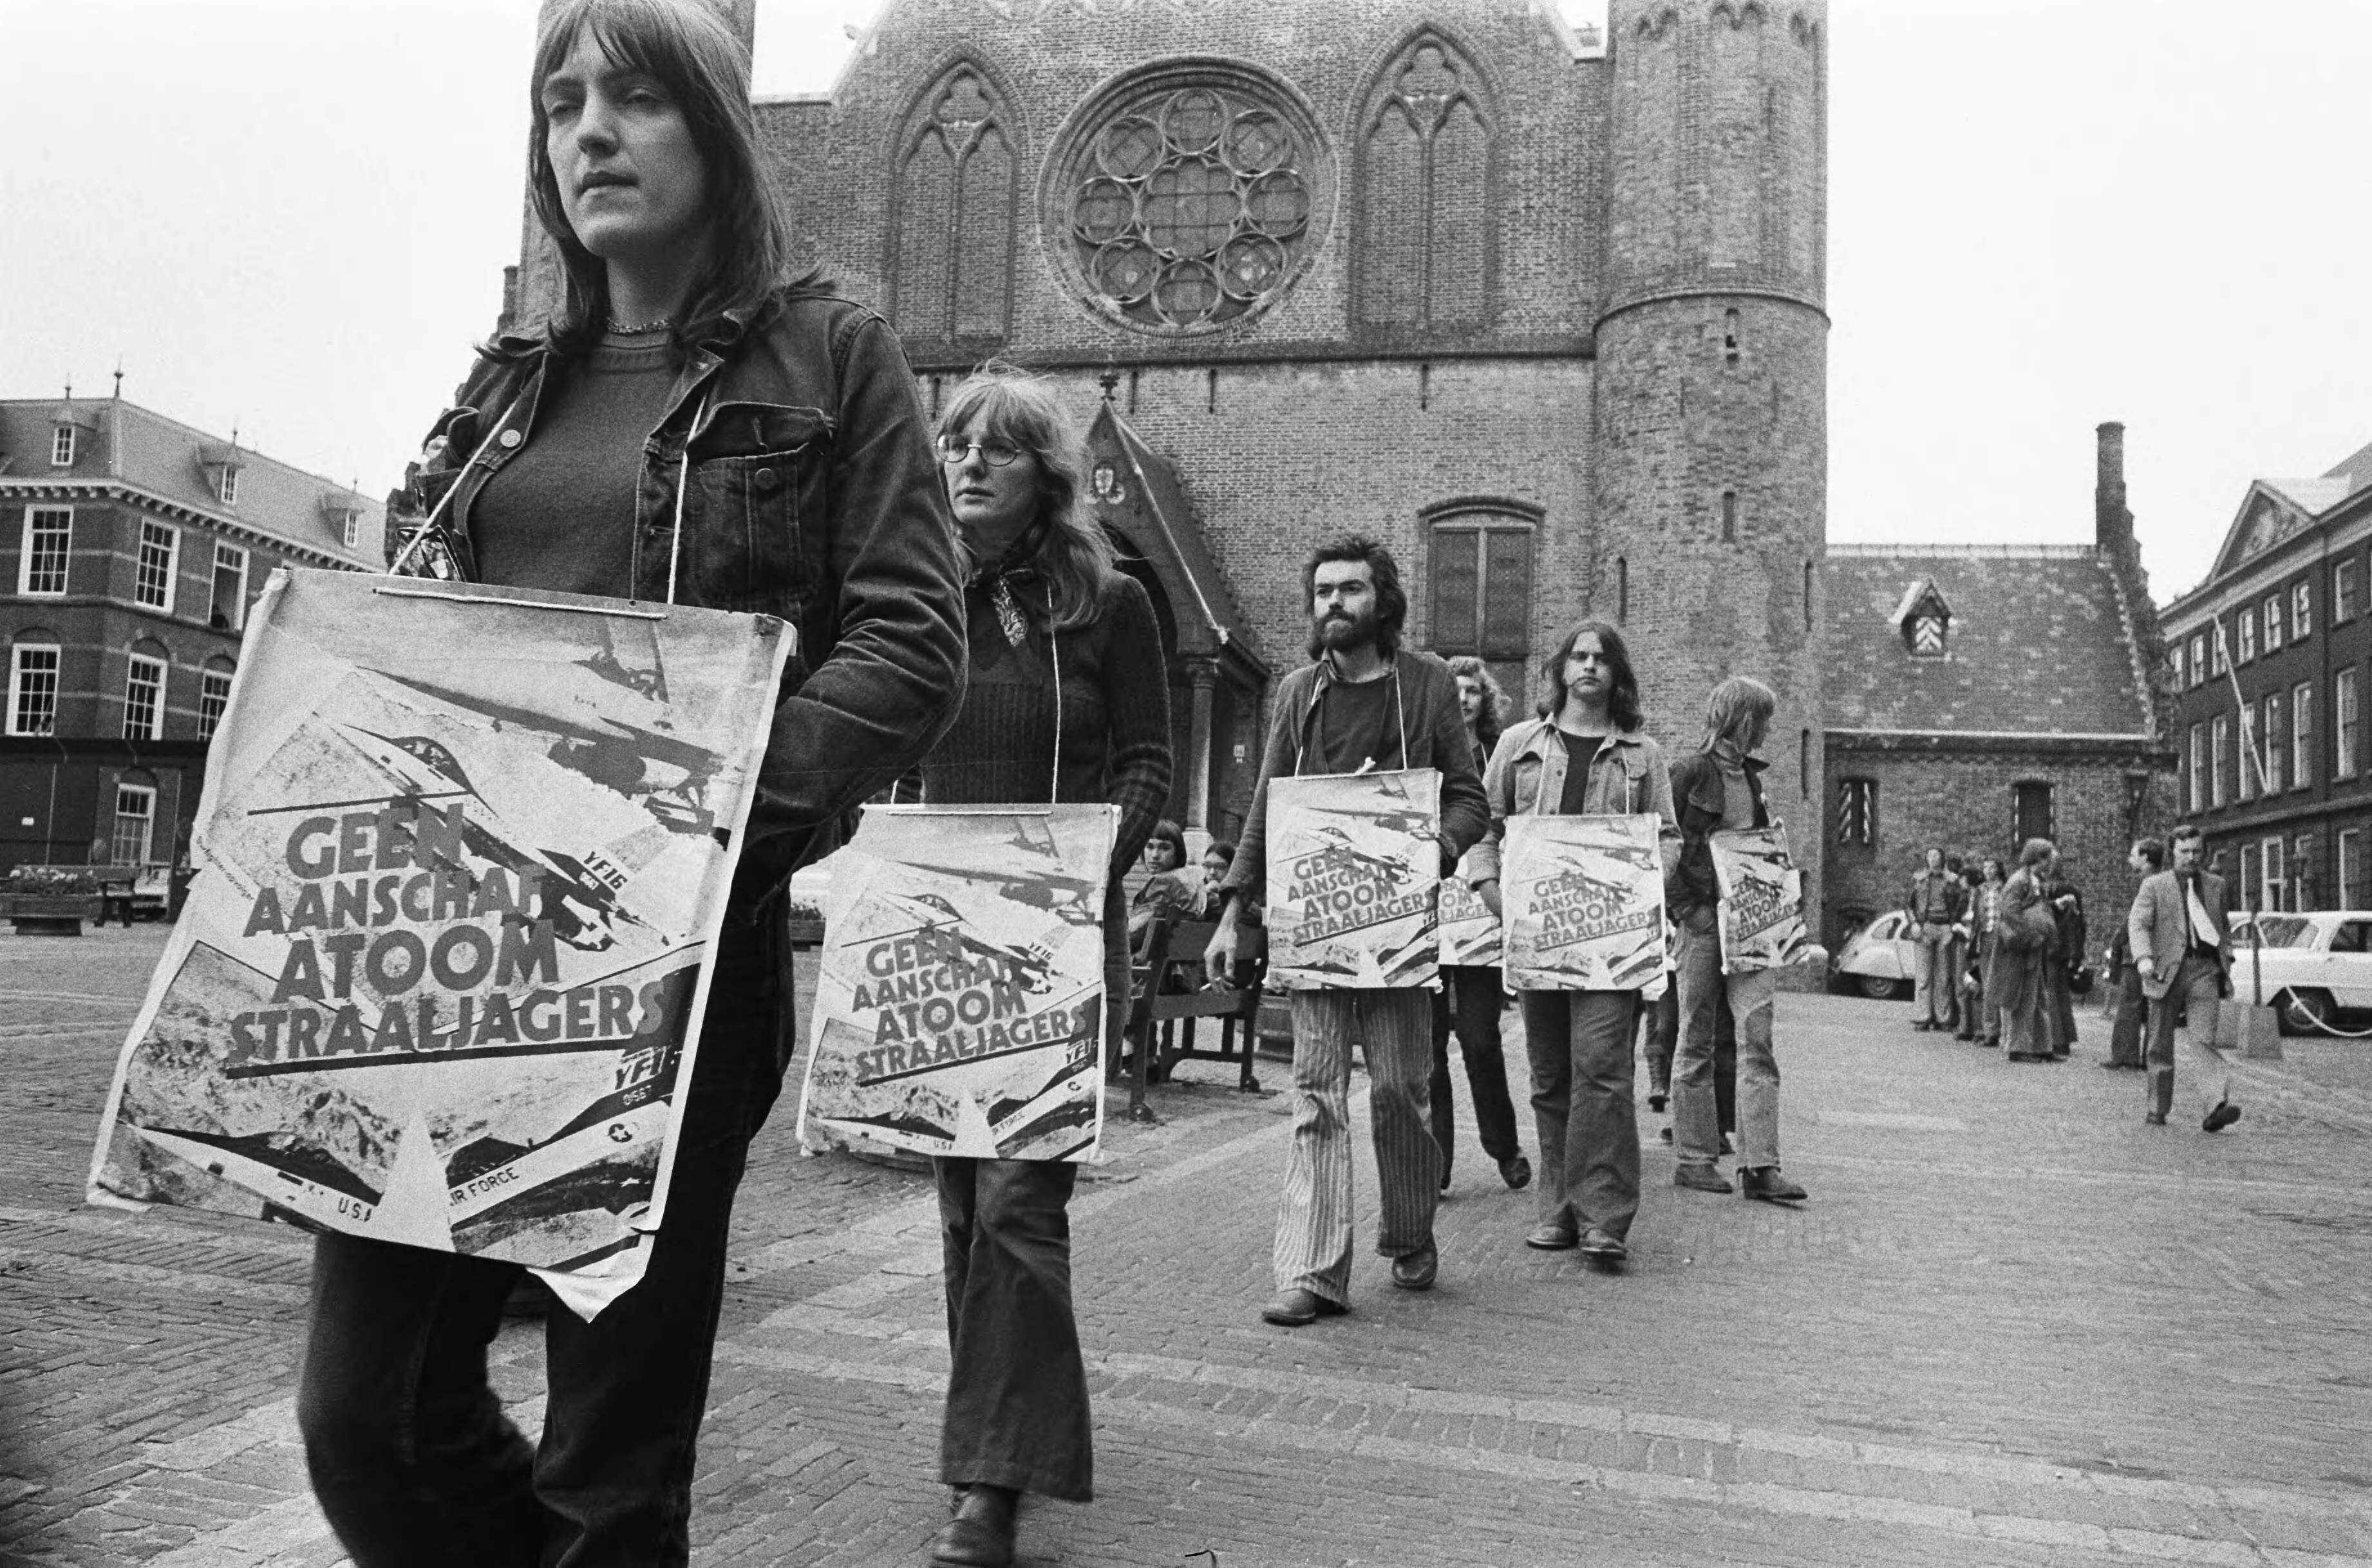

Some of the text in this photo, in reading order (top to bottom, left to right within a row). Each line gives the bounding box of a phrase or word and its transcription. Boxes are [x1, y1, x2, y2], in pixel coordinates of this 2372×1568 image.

[286, 803, 464, 880] GEEN
[1294, 846, 1353, 879] GEEN
[583, 851, 628, 890] YF16
[1288, 863, 1386, 902] AANSCHAF
[1534, 872, 1586, 897] GEEN
[243, 863, 548, 937] AANSCHAF
[1292, 890, 1435, 944] STRAALJAGERS
[1303, 877, 1397, 922] ATOOM
[1543, 899, 1623, 931] ATOOM
[270, 919, 560, 1004] ATOOM
[867, 926, 963, 977] GEEN
[852, 953, 1012, 1013] AANSCHAF
[227, 980, 664, 1064] STRAALJAGERS
[874, 980, 1026, 1045] ATOOM
[855, 1005, 1087, 1081] STRAALJAGERS
[467, 1166, 520, 1197] FORCE
